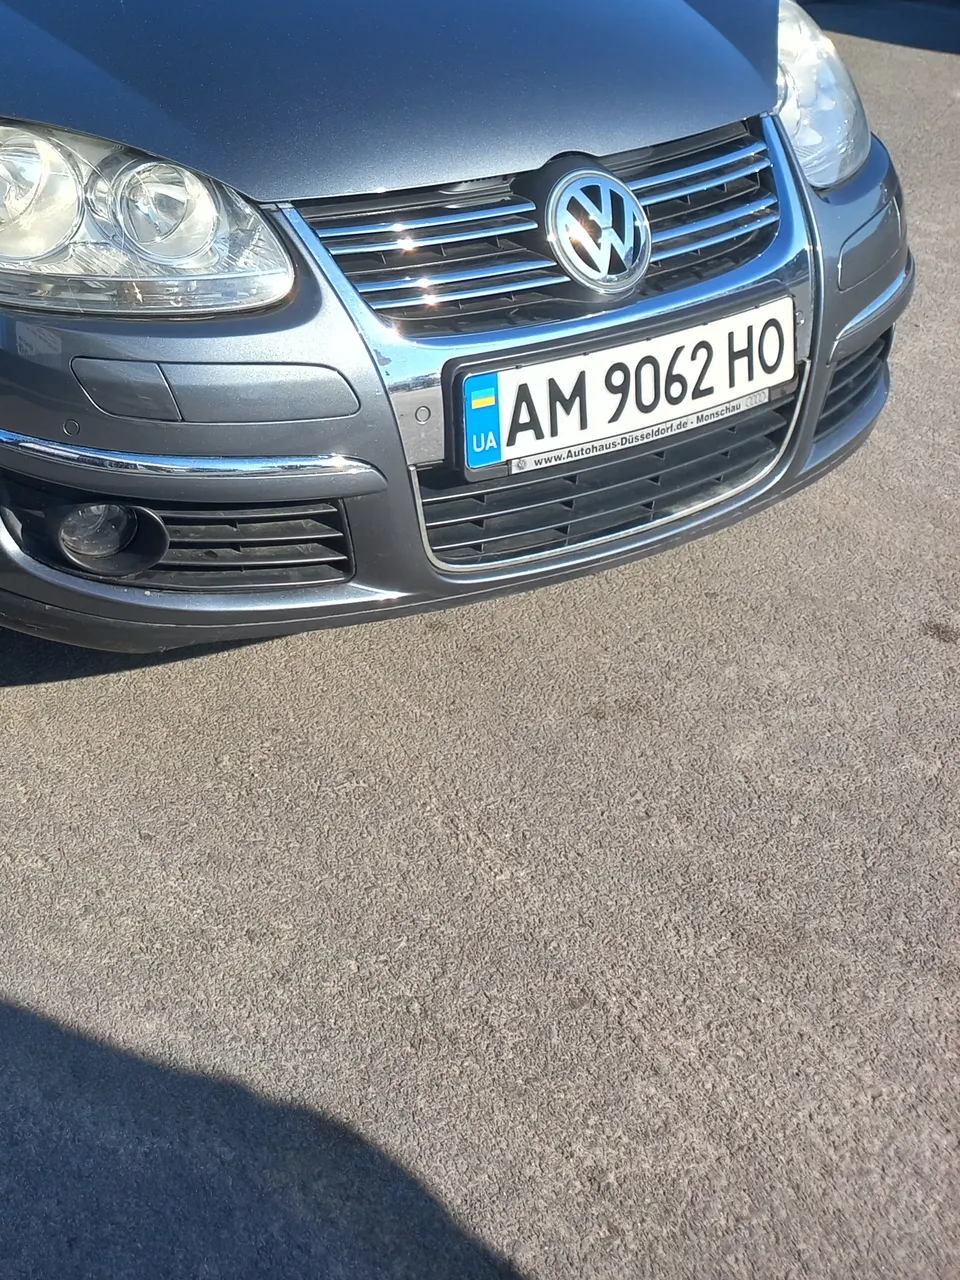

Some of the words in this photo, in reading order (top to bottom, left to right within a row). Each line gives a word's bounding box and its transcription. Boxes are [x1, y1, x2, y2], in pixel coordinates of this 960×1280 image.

[506, 370, 589, 447] AM
[604, 340, 714, 424] 9062
[727, 317, 785, 388] HO
[472, 431, 498, 453] UA
[534, 421, 688, 466] www.Autohaus-Düsseldorf.de
[696, 402, 741, 424] Monschau
